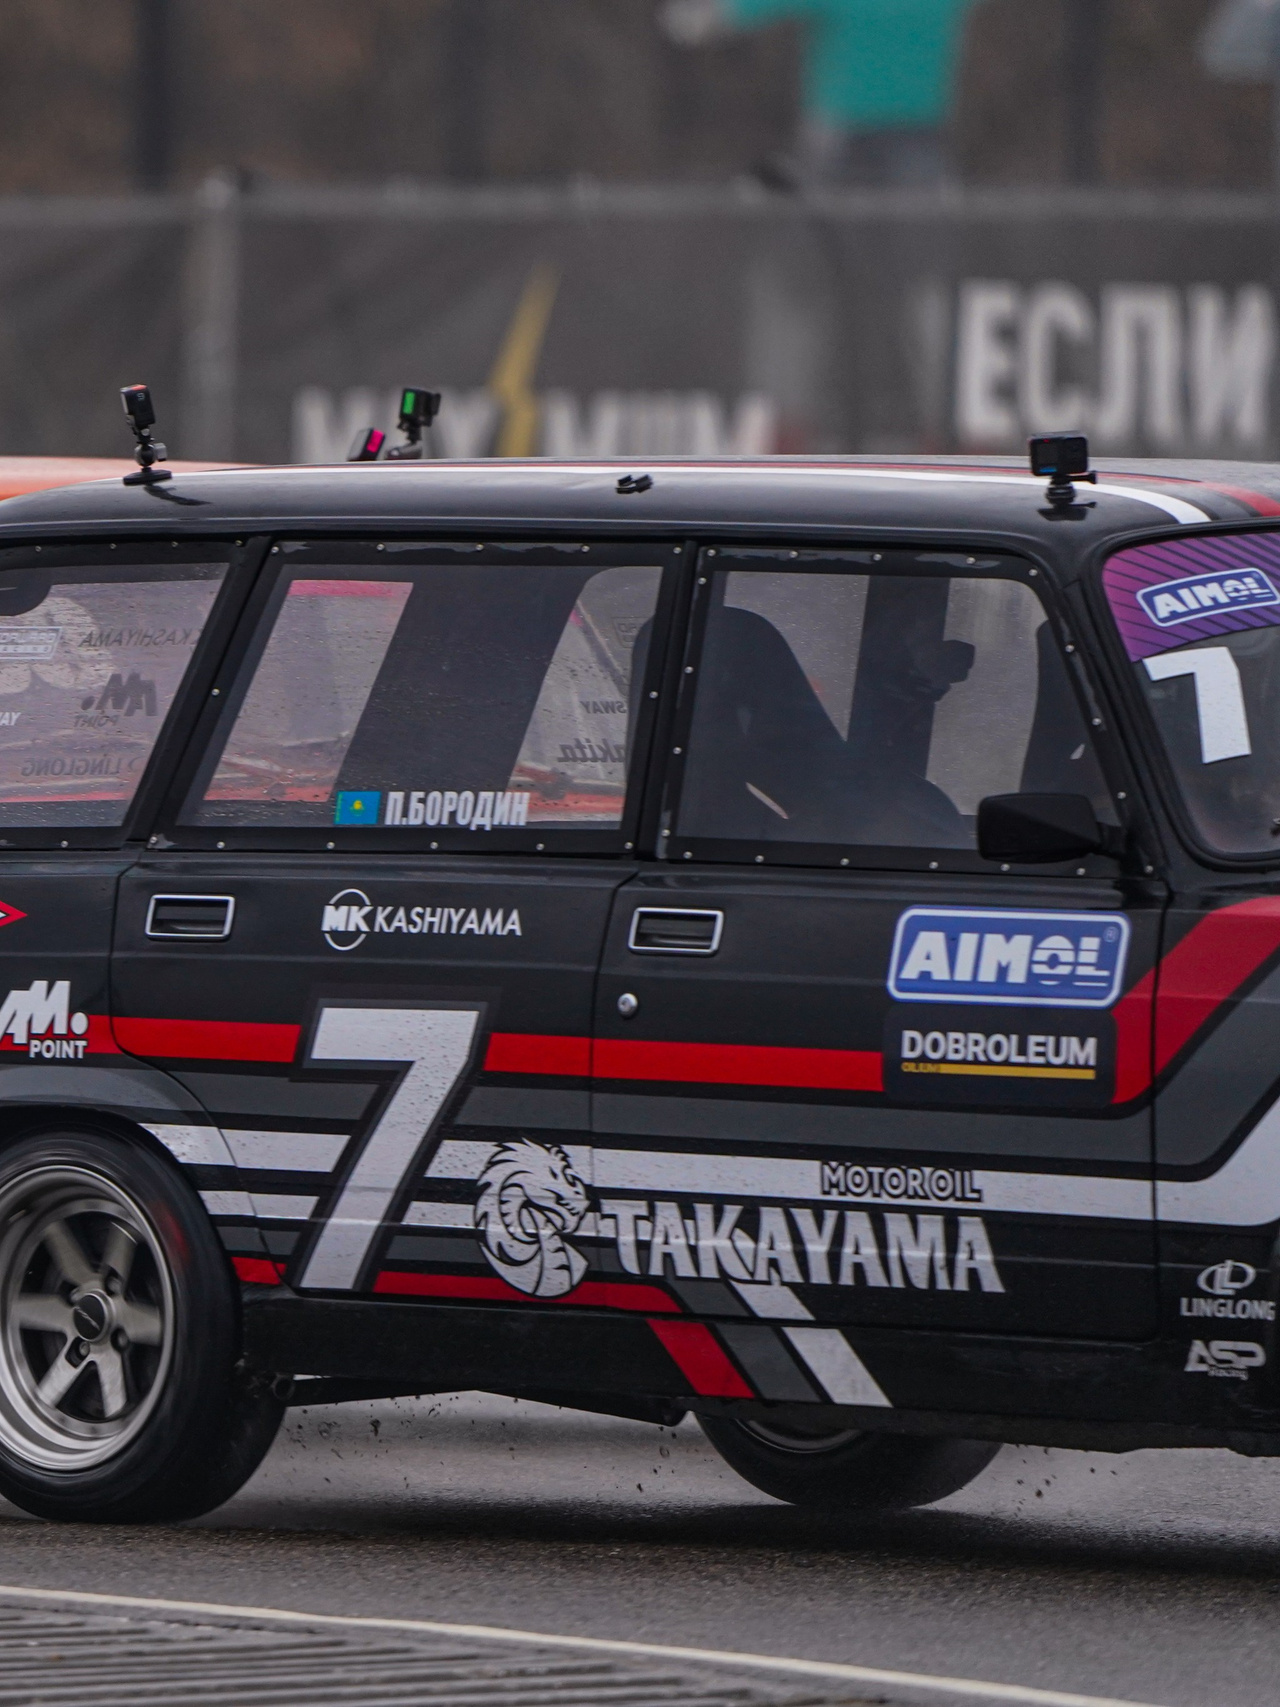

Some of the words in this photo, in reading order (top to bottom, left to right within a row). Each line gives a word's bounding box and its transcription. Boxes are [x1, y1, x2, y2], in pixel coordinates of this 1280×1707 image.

[957, 274, 1271, 445] ЕСЛИ
[1152, 577, 1274, 619] AIMOL
[1142, 646, 1252, 764] 7
[384, 790, 531, 831] П.БОРОДИН
[321, 904, 374, 932] MK
[374, 905, 523, 937] KASHIYAMA
[898, 930, 1111, 987] AIMOL
[29, 1038, 88, 1059] POINT
[901, 1029, 1098, 1067] DOBROLEUM
[298, 1007, 481, 1290] 7
[822, 1163, 929, 1198] MOTOR
[929, 1167, 982, 1201] OIL
[600, 1199, 1006, 1293] TAKAYAMA
[1180, 1297, 1276, 1321] LINGLONG
[1183, 1339, 1267, 1372] ASP
